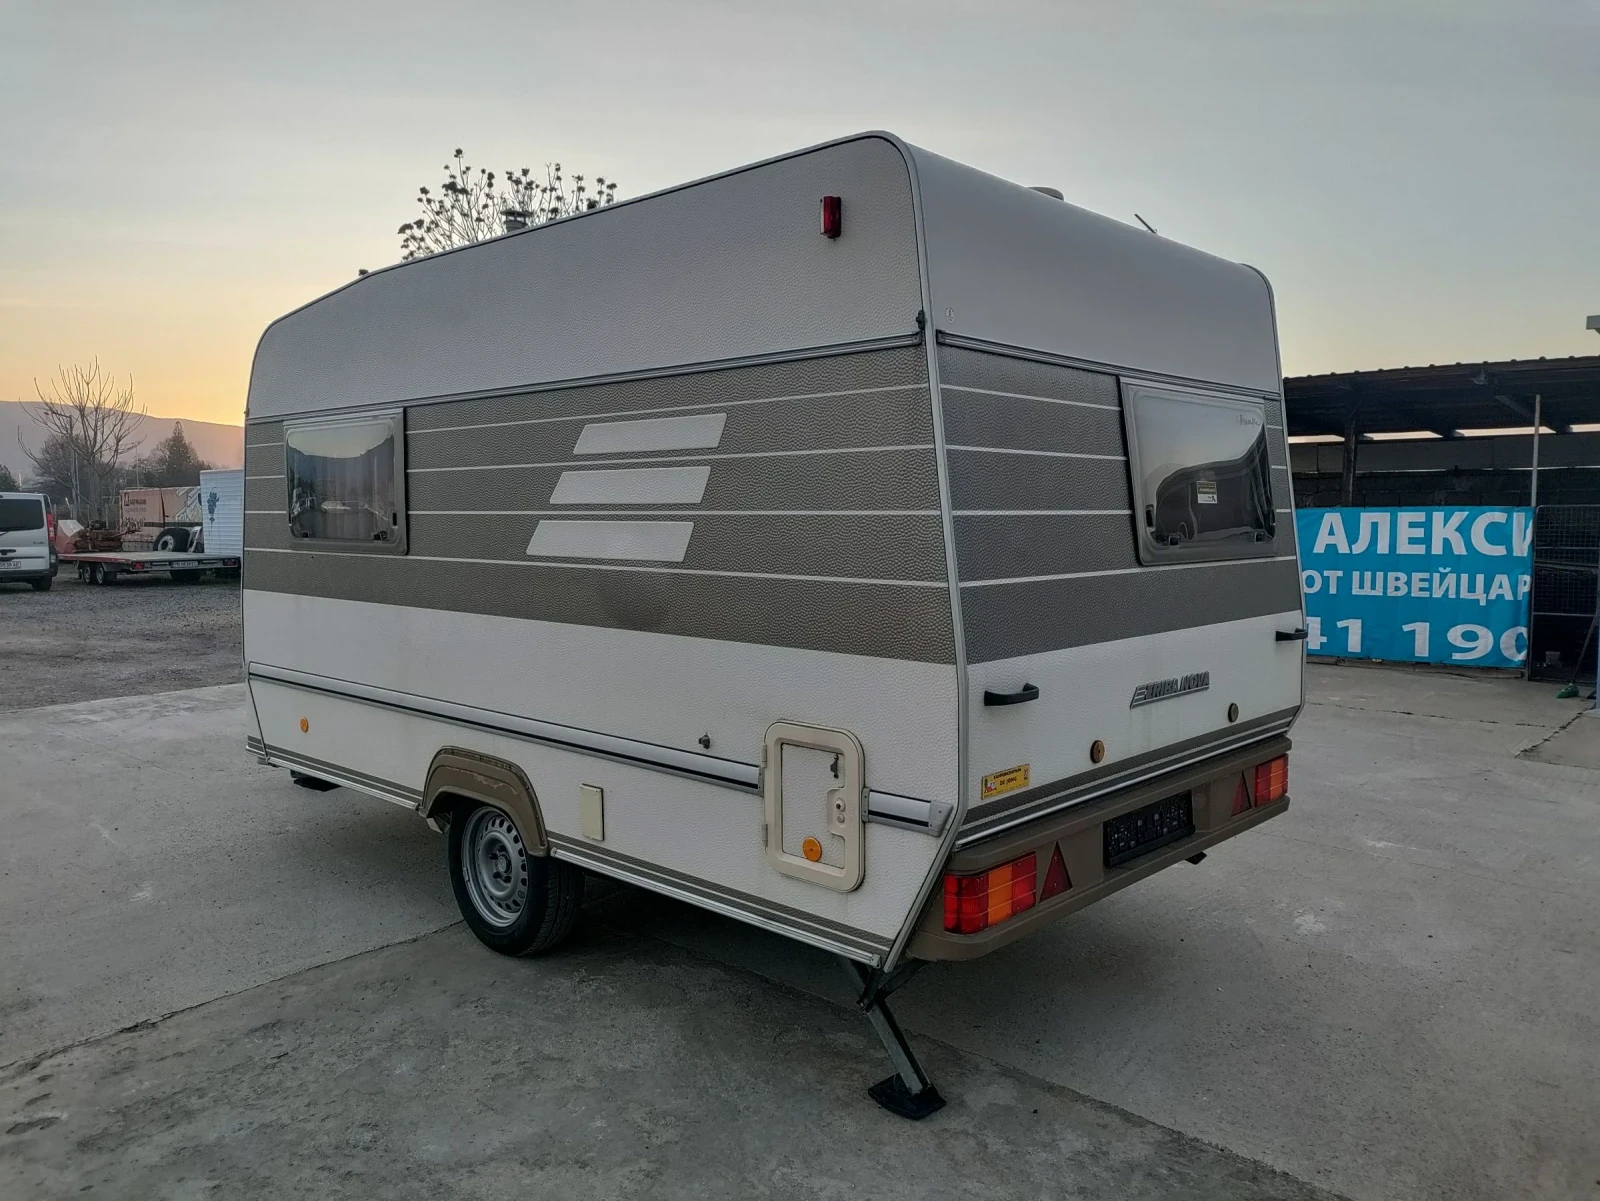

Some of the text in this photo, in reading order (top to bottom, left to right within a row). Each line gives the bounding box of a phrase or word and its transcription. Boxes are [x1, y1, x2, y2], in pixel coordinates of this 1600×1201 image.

[1303, 567, 1531, 606] ОТ ШВЕЙЦАР
[1179, 671, 1210, 692] NOVA
